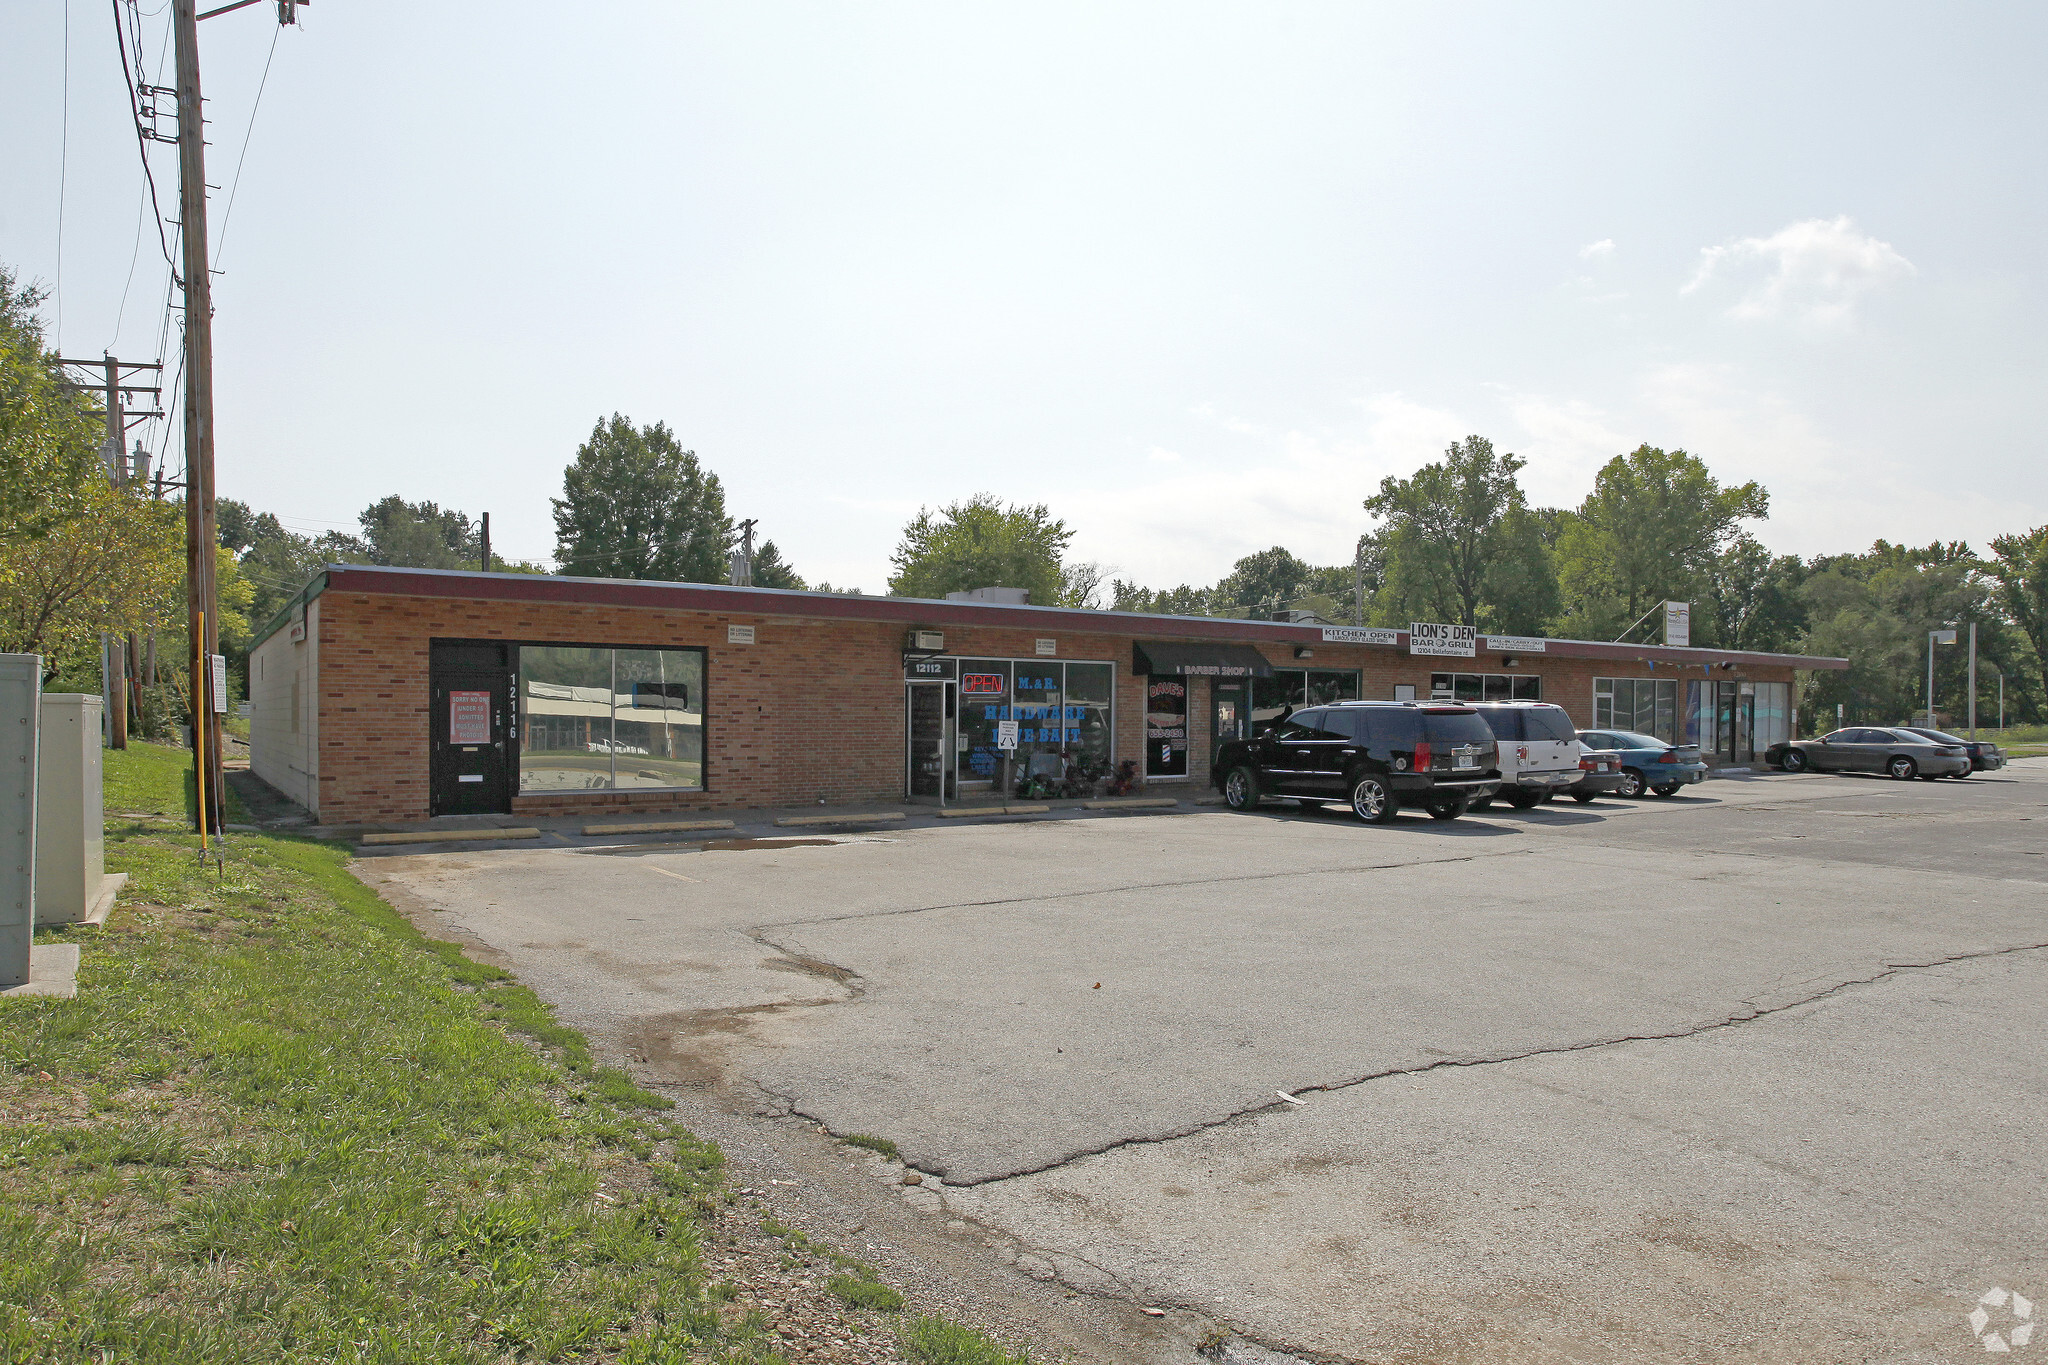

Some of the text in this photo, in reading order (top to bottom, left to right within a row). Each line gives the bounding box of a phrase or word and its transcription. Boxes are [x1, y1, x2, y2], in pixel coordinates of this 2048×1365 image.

[1325, 629, 1395, 639] KITCHEN OPEN
[1411, 624, 1475, 641] LION'S DEN
[1411, 638, 1474, 649] BAR GRILL
[916, 663, 941, 673] 12112
[1184, 665, 1245, 676] BARBER SHOP
[964, 675, 1001, 692] OPEN
[1149, 682, 1184, 698] DAVE'S
[984, 705, 1086, 720] HARDWARE
